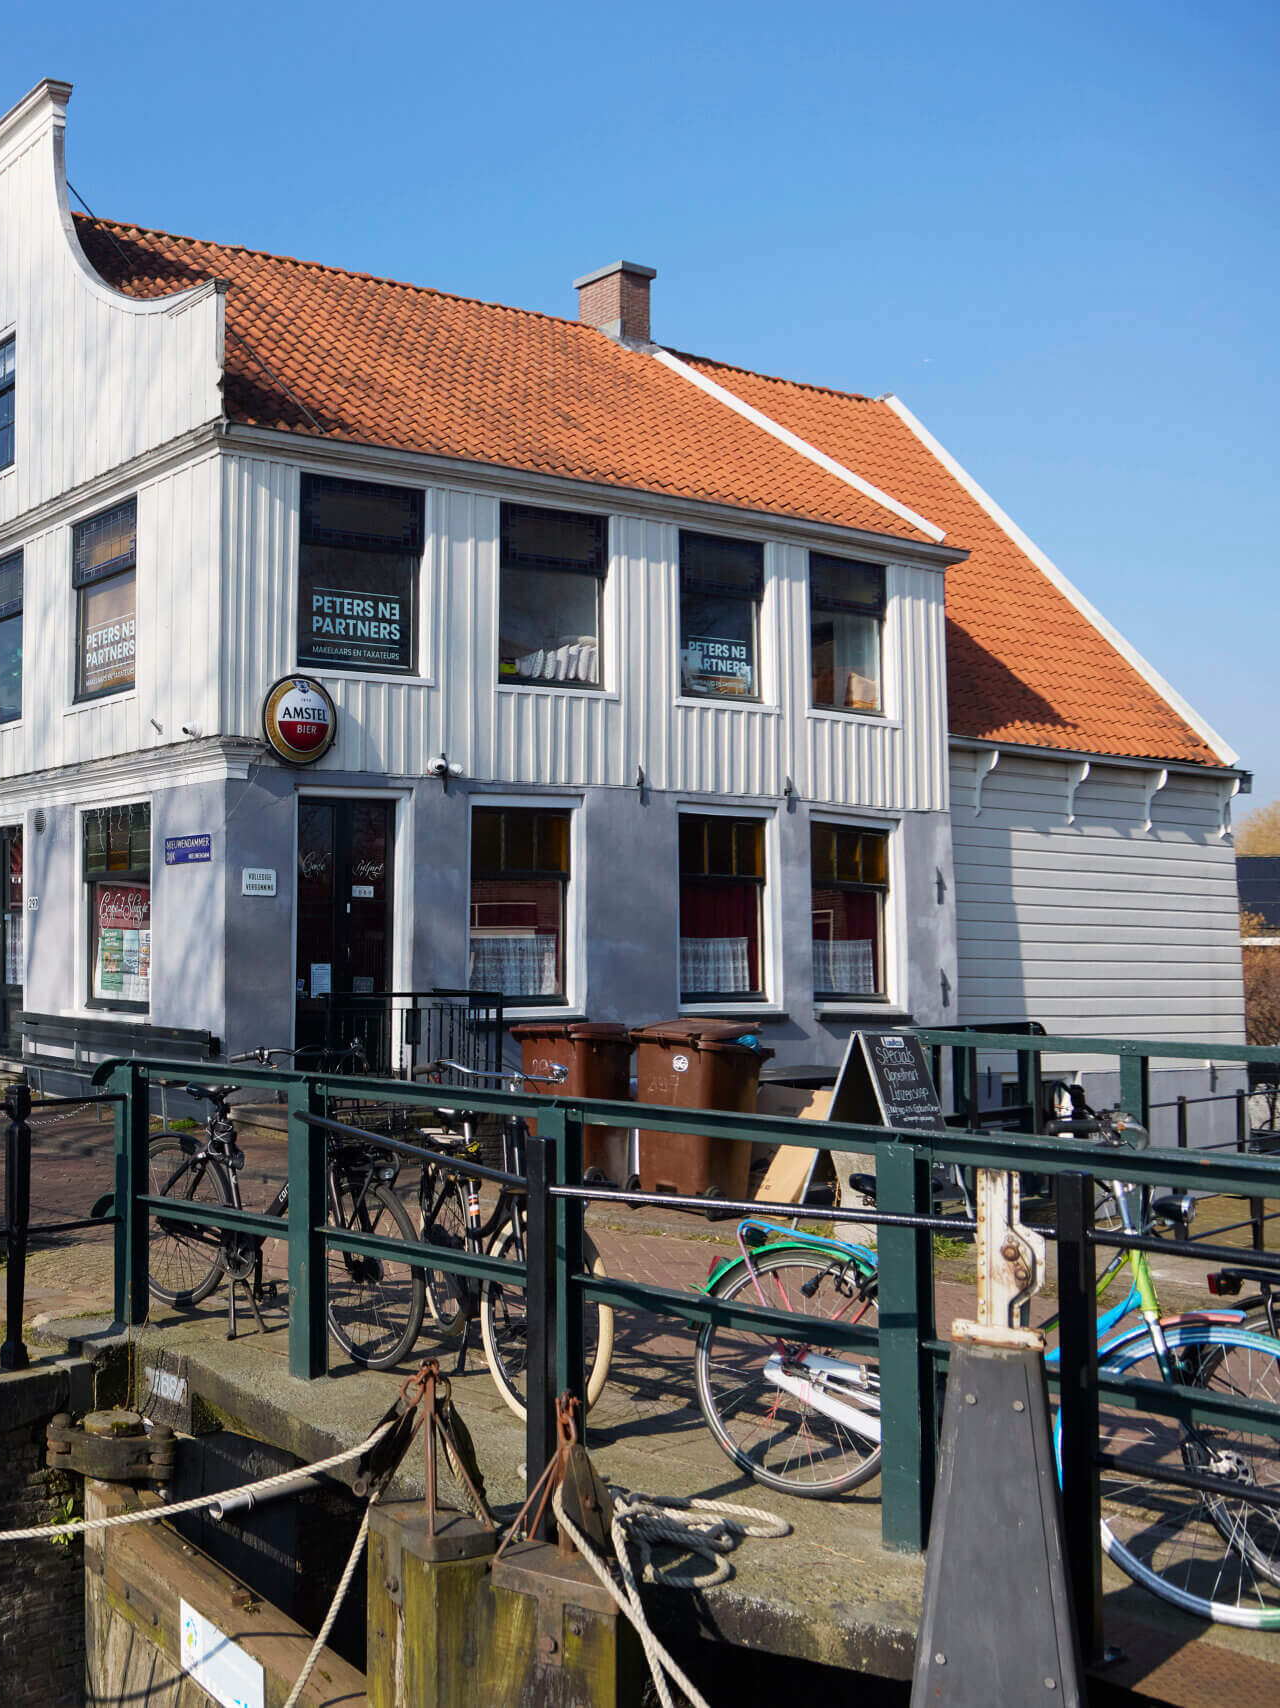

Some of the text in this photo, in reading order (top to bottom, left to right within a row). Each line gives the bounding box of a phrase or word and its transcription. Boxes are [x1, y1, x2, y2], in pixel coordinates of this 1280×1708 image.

[312, 595, 374, 618] PETERS
[312, 616, 400, 640] PARTNERS
[86, 625, 120, 650] PETERS
[86, 639, 135, 668] PARTNERS
[312, 645, 400, 661] MAKELAARS EN TAXATEURS
[688, 641, 729, 657] PETERS
[282, 706, 328, 722] AMSTEL
[296, 724, 318, 735] BIER
[166, 837, 210, 850] NIEUWENDAMMER
